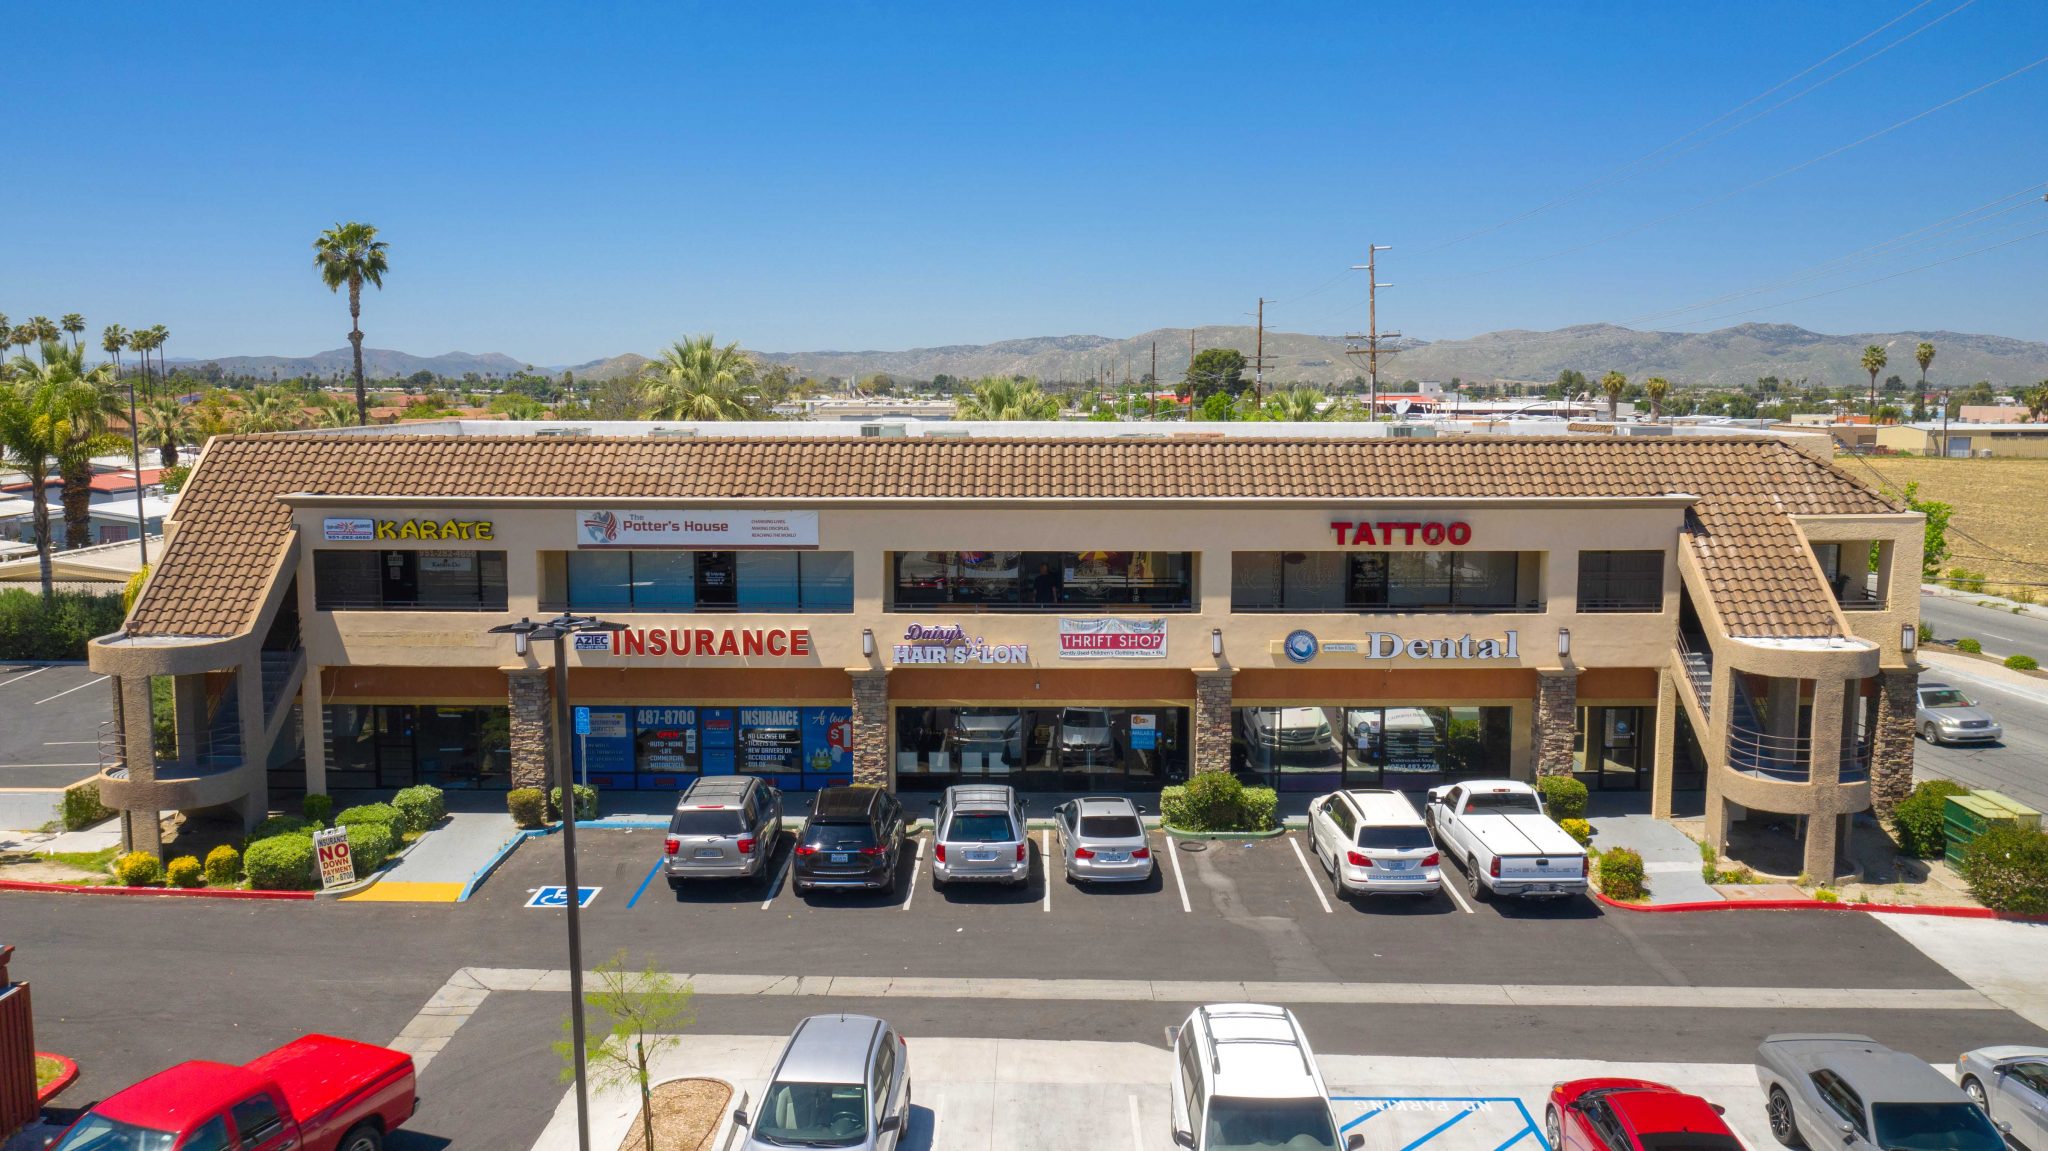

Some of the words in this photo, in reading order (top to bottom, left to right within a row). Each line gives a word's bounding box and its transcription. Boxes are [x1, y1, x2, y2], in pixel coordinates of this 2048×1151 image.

[629, 513, 644, 521] The
[377, 518, 494, 541] KARATE
[623, 520, 680, 532] Potter's
[684, 520, 728, 532] House
[1330, 521, 1472, 546] TATTOO
[575, 634, 608, 645] AZTEC
[903, 623, 965, 645] Daisy's
[1063, 635, 1113, 647] THRIFT
[1119, 635, 1161, 647] SHOP
[612, 629, 810, 657] INSURANCE
[1365, 630, 1521, 660] Dental
[893, 644, 948, 664] HAIR
[953, 640, 1028, 664] SALON
[637, 709, 695, 725] 487-8700
[741, 710, 799, 725] INSURANCE
[318, 834, 347, 847] INSURANCE
[319, 843, 349, 862] NO
[322, 864, 352, 877] PAYMENT
[323, 858, 349, 869] DOWN
[1354, 1100, 1450, 1112] PARKING
[1462, 1100, 1493, 1112] NO
